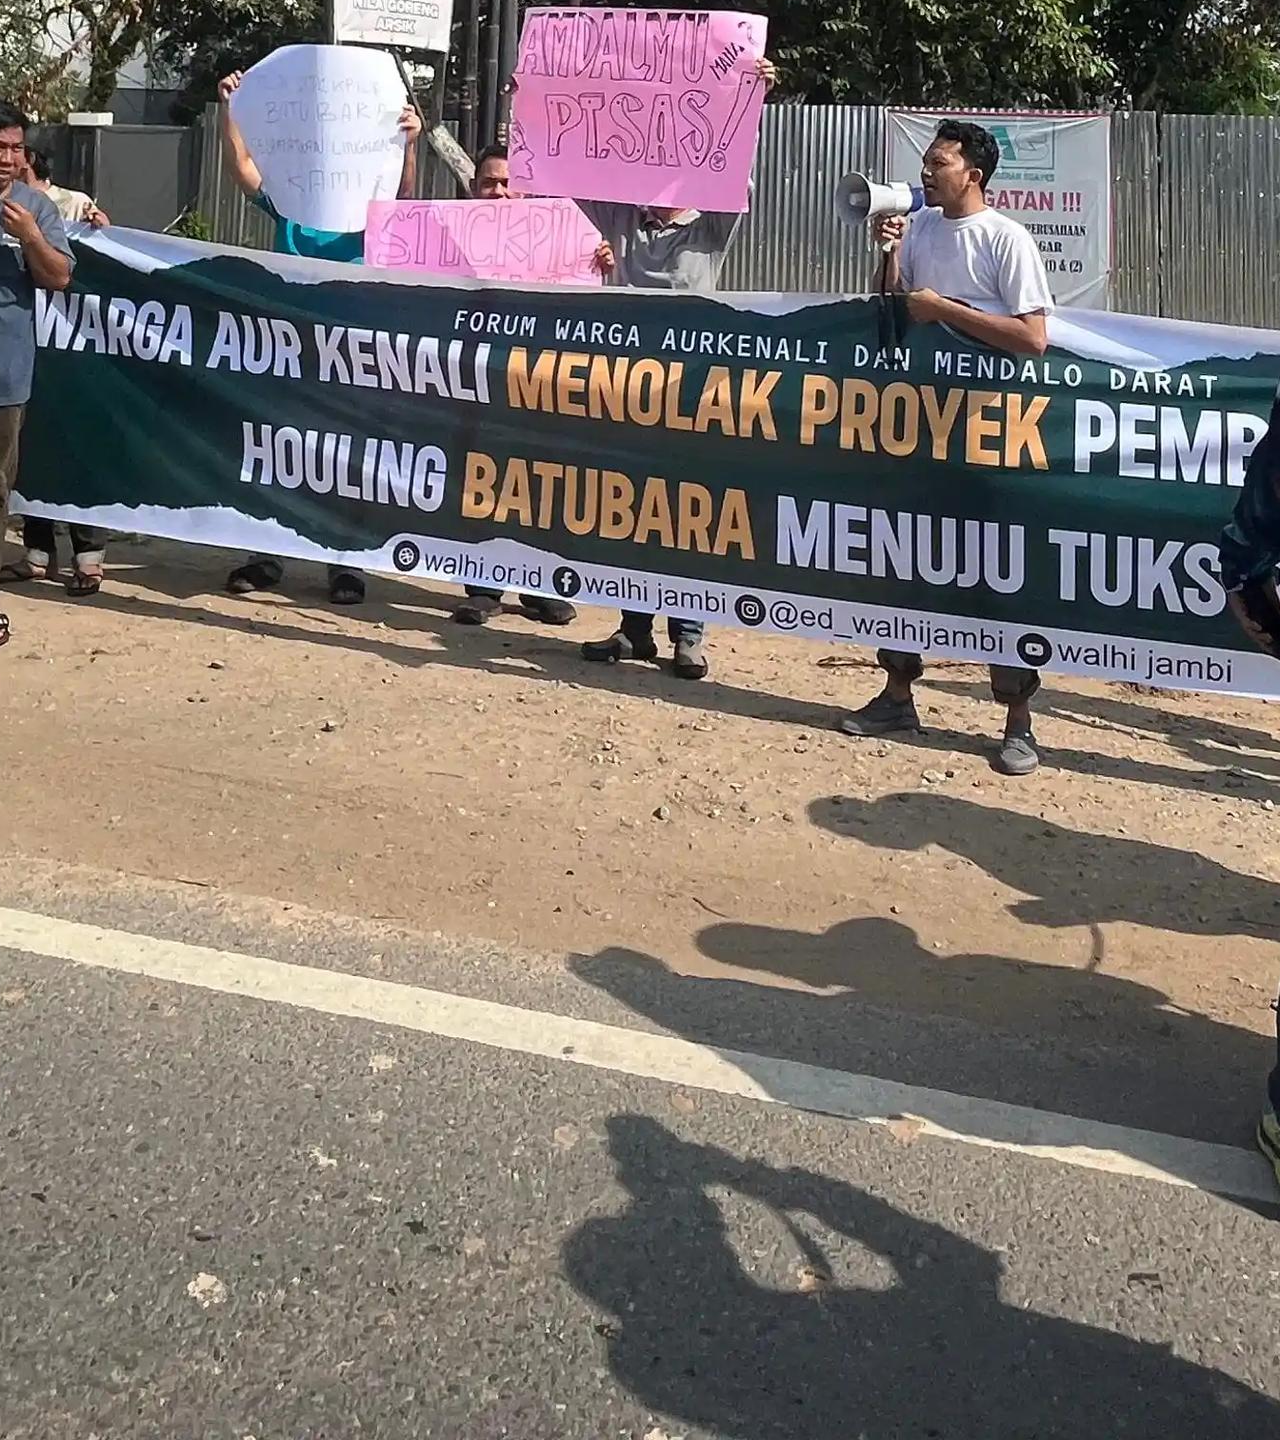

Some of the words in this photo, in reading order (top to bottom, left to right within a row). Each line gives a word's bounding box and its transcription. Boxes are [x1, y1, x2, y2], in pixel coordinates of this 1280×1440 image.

[375, 16, 417, 35] ARSIK
[517, 12, 709, 84] AMDALMU
[34, 288, 194, 366] WARGA
[205, 310, 302, 379] AUR
[314, 323, 491, 404] KENALI
[506, 346, 783, 441] MENOLAK
[799, 373, 1051, 471] PROYEK
[454, 310, 537, 338] FORUM
[555, 318, 641, 348] WARGA
[661, 328, 829, 365] AURKENALI
[854, 343, 911, 372] DAN
[934, 351, 1084, 388] MENDALO
[1110, 370, 1219, 399] DARAT
[240, 421, 448, 513] HOULING
[461, 451, 756, 561] BATUBARA
[775, 494, 1026, 595] MENUJU
[1048, 527, 1227, 617] TUKS
[424, 550, 543, 590] walhi.or.id
[585, 575, 648, 604] walhi
[655, 583, 728, 615] jambi
[768, 599, 1005, 655] @ed_walhijambi
[1058, 640, 1137, 671] walhi
[1144, 648, 1234, 685] jambi
